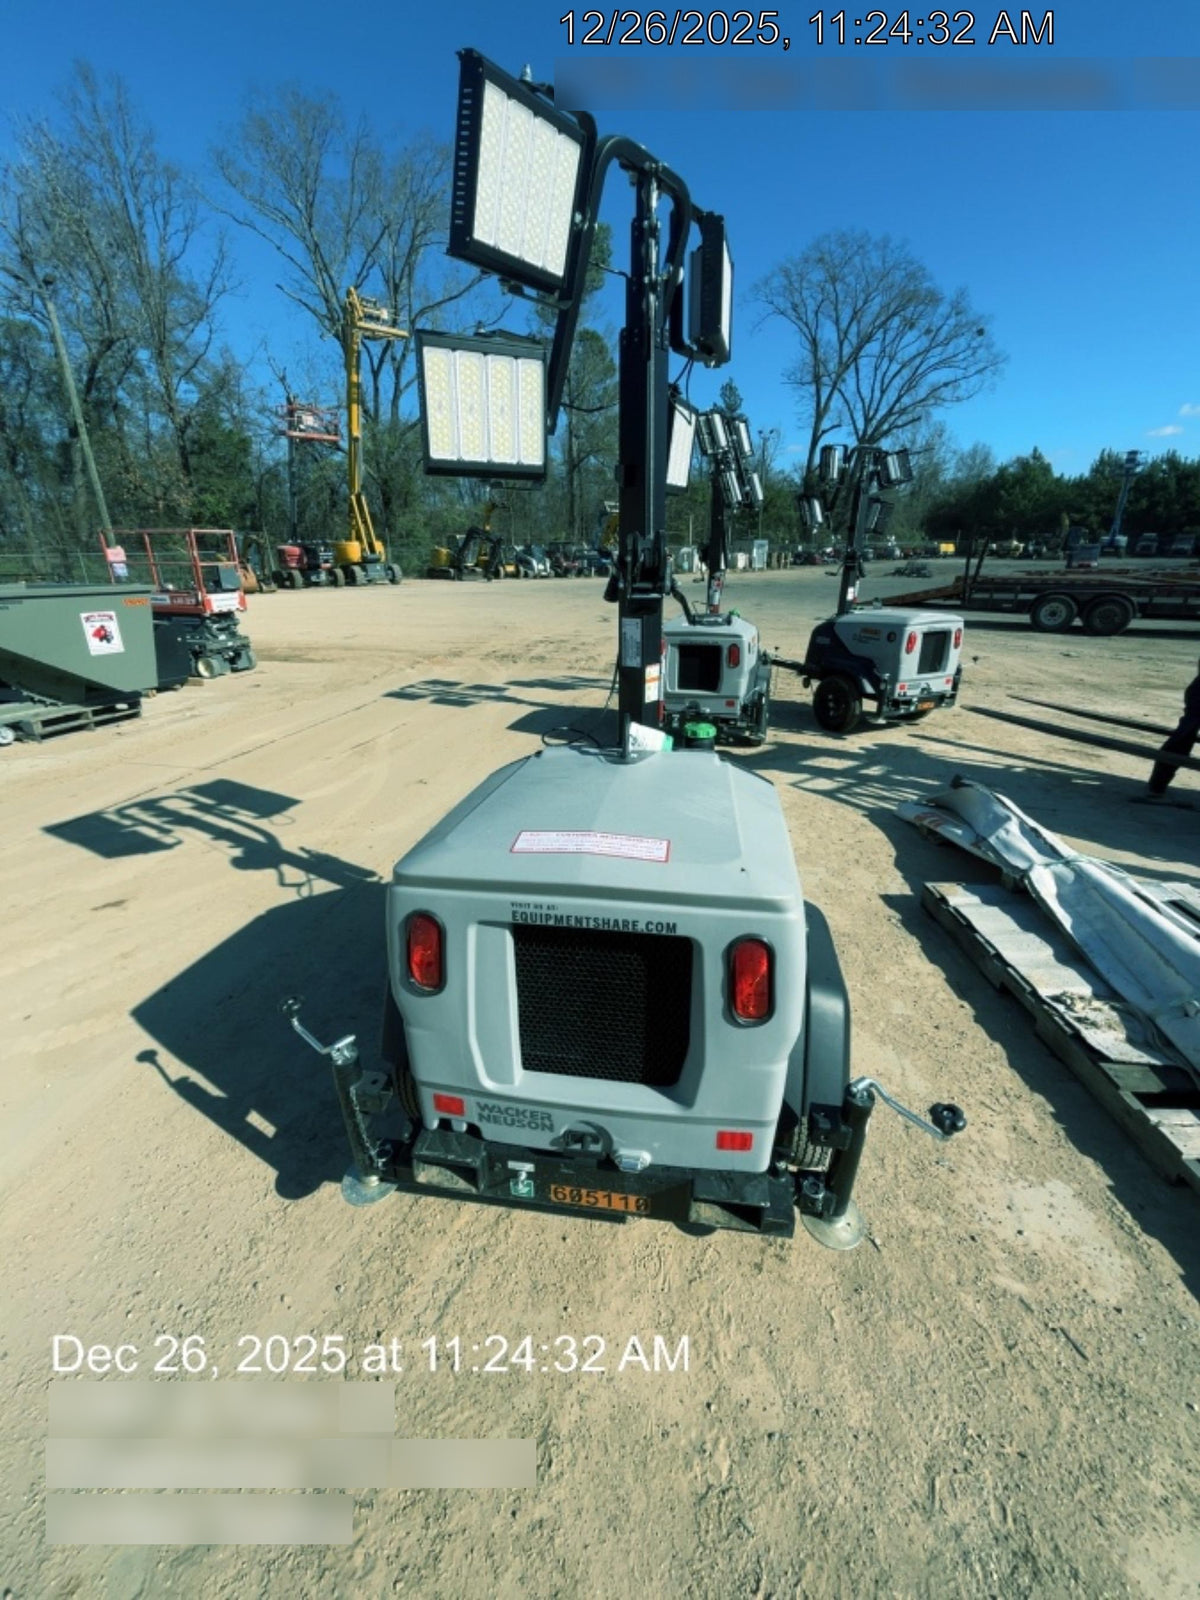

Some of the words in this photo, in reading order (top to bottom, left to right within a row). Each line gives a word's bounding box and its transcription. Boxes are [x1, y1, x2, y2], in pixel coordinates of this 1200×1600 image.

[511, 910, 678, 934] EQUIPMENTSHARE.COM
[476, 1102, 552, 1121] WACKER
[478, 1113, 555, 1133] NEUSON
[553, 1186, 649, 1211] 605110
